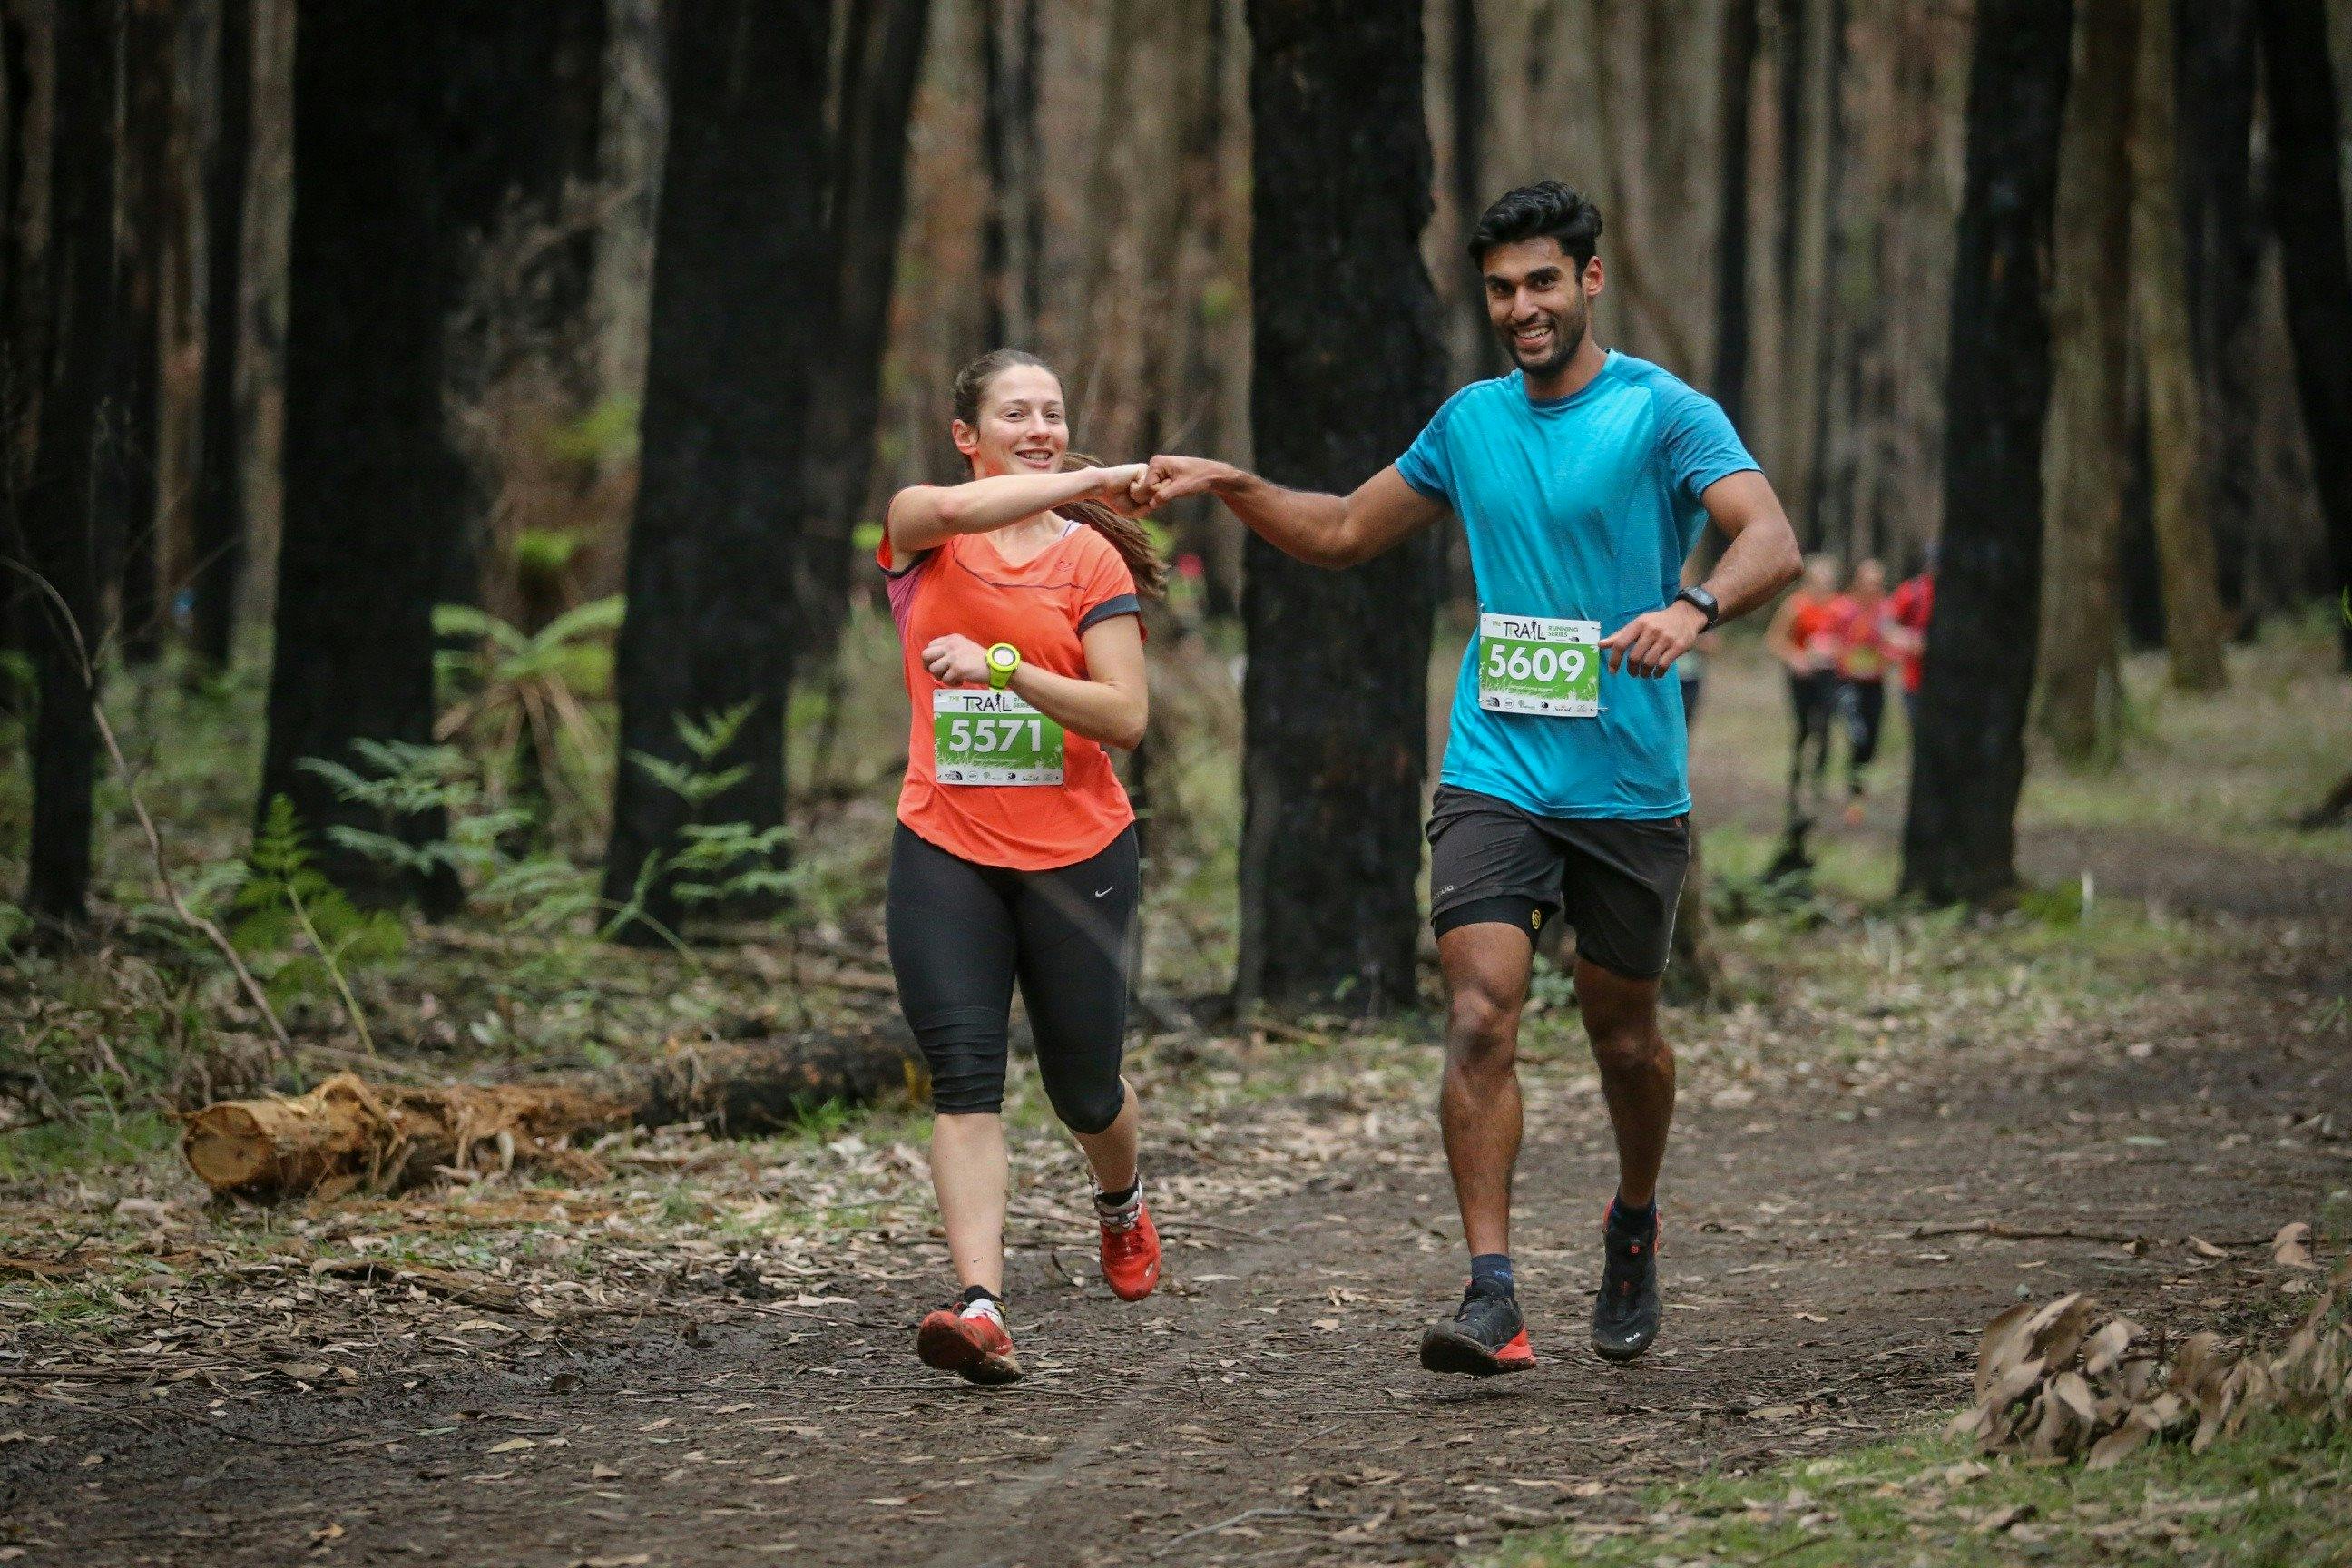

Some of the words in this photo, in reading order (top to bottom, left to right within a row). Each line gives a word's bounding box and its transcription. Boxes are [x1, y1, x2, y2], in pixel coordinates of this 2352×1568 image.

[1503, 619, 1546, 641] TRAIL
[1488, 643, 1586, 682] 5609
[962, 692, 1012, 712] TRAIL
[948, 719, 1041, 753] 5571
